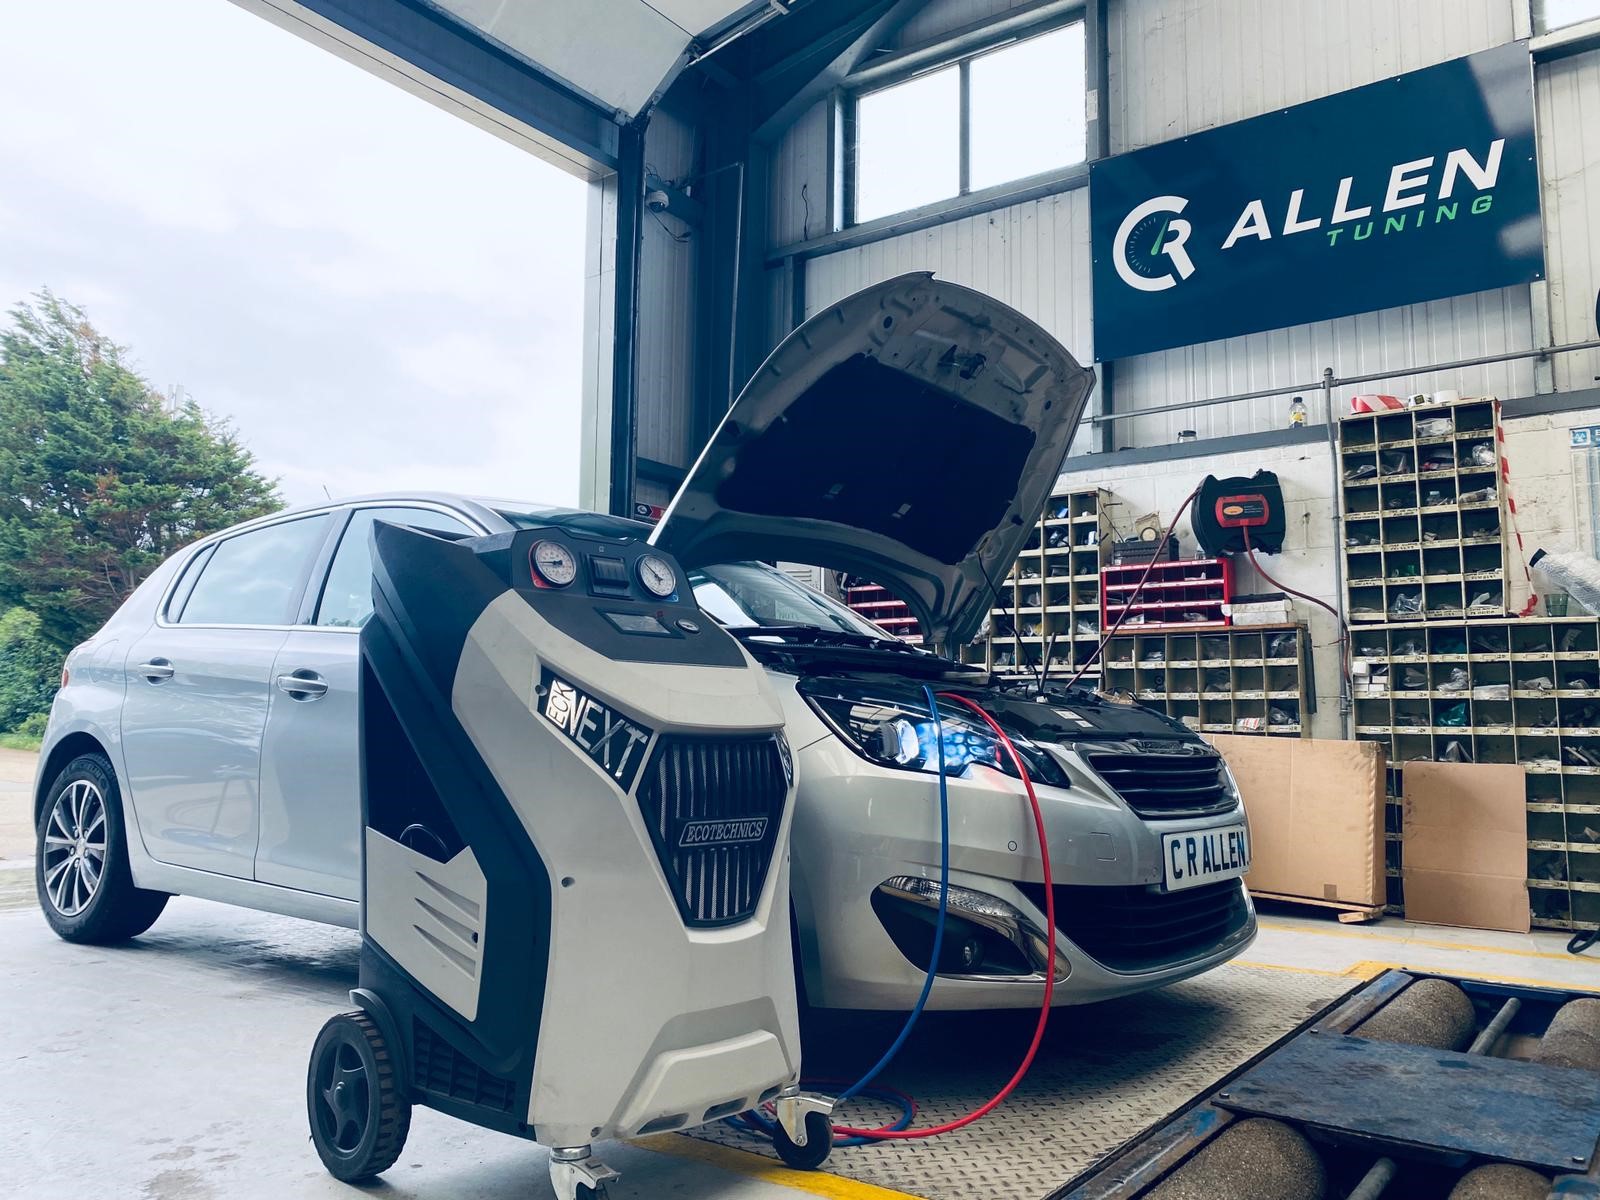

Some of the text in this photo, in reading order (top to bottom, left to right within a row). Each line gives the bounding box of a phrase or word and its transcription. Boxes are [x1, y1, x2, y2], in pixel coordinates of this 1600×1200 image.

[1221, 138, 1506, 250] ALLEN
[1326, 194, 1495, 247] TUNING
[547, 680, 649, 778] ECK NEXT
[685, 820, 763, 843] ECOTECHNICS
